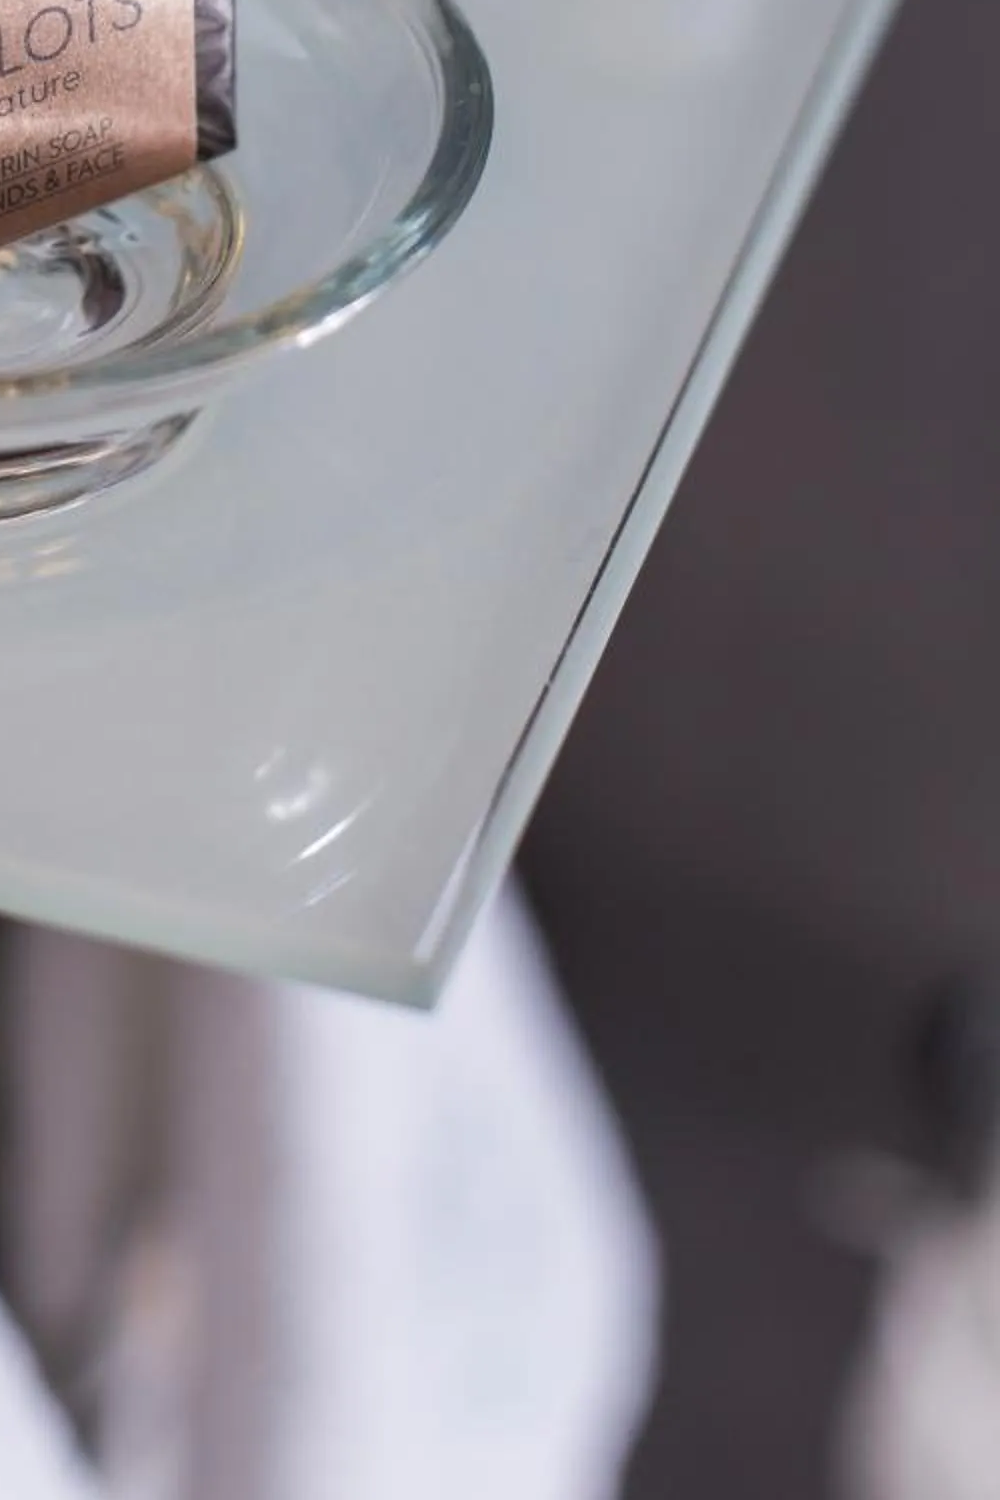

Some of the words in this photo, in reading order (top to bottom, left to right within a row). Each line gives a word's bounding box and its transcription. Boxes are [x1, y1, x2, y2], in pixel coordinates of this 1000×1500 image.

[49, 117, 113, 160] SOAP
[44, 168, 60, 193] &
[66, 147, 125, 183] FACE
